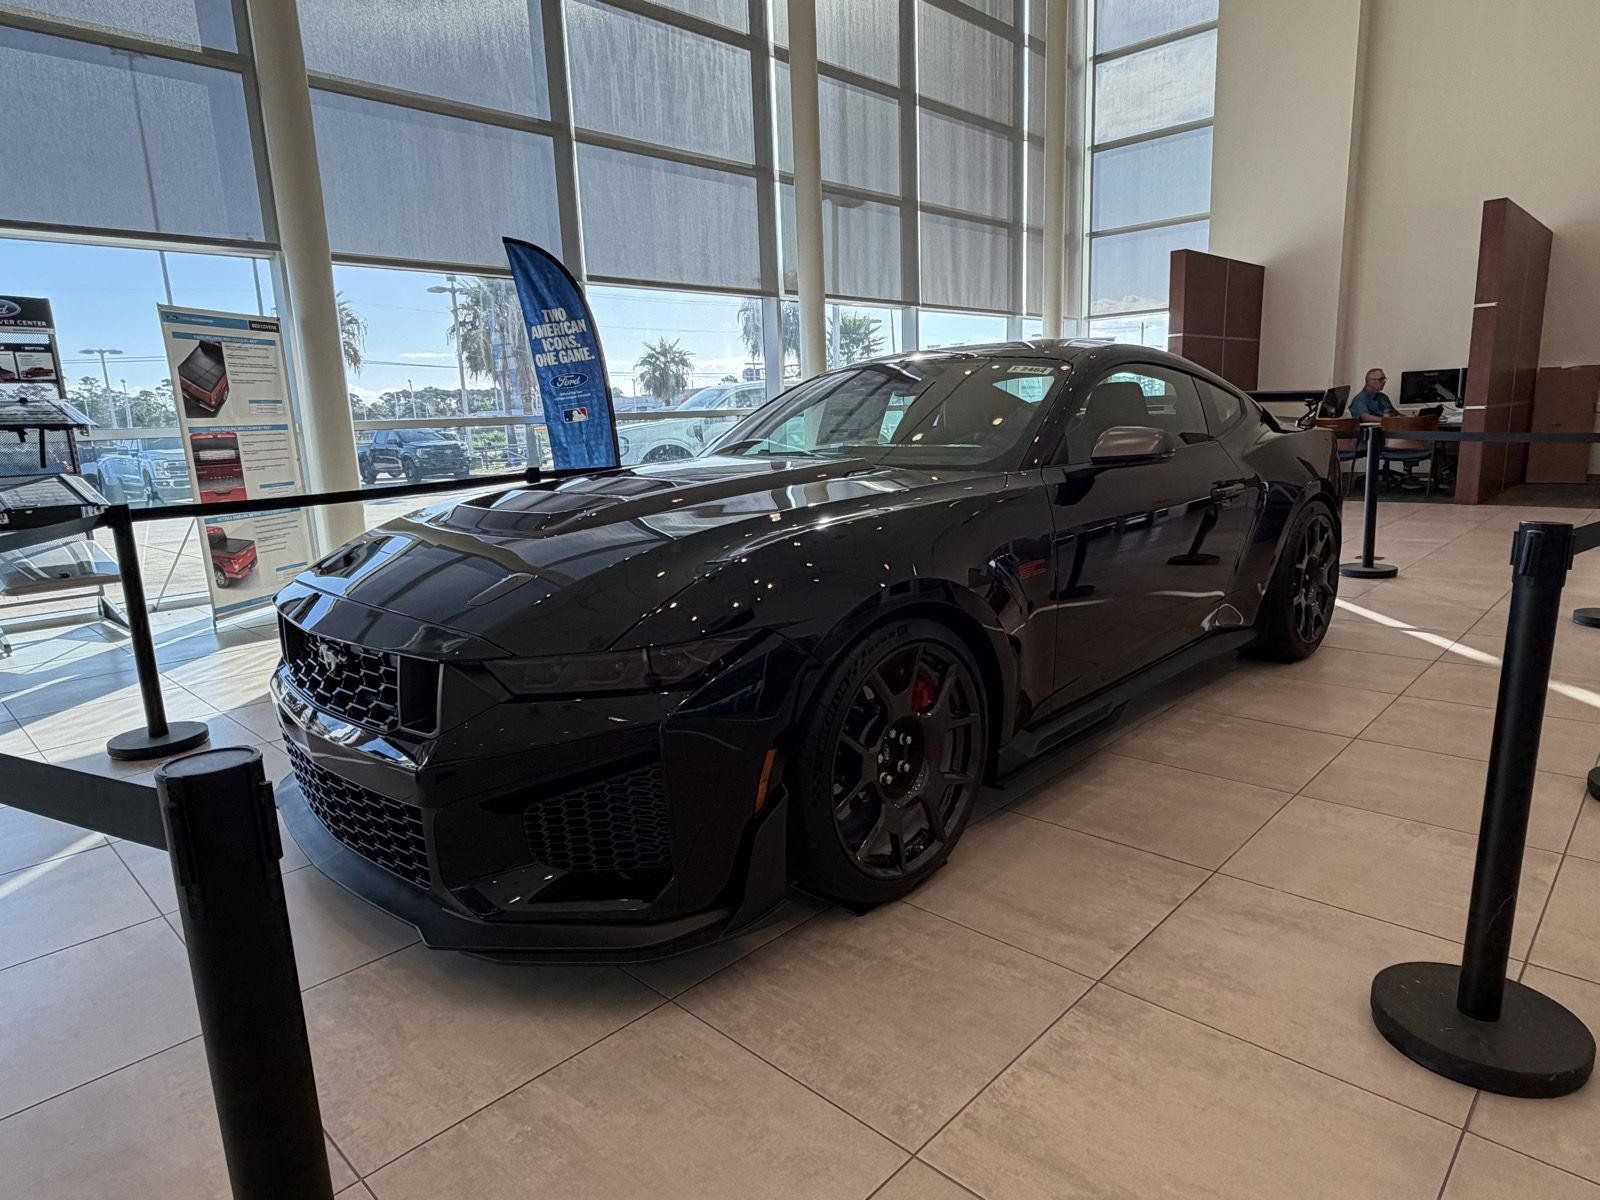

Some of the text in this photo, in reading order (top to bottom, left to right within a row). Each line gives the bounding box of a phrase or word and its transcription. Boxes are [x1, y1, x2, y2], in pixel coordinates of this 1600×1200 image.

[541, 308, 566, 322] TWO
[17, 319, 47, 327] CENTER
[531, 319, 587, 340] AMERICAN
[541, 335, 581, 352] ICONS.
[535, 347, 596, 368] ONE GAME.
[556, 375, 580, 387] Ford
